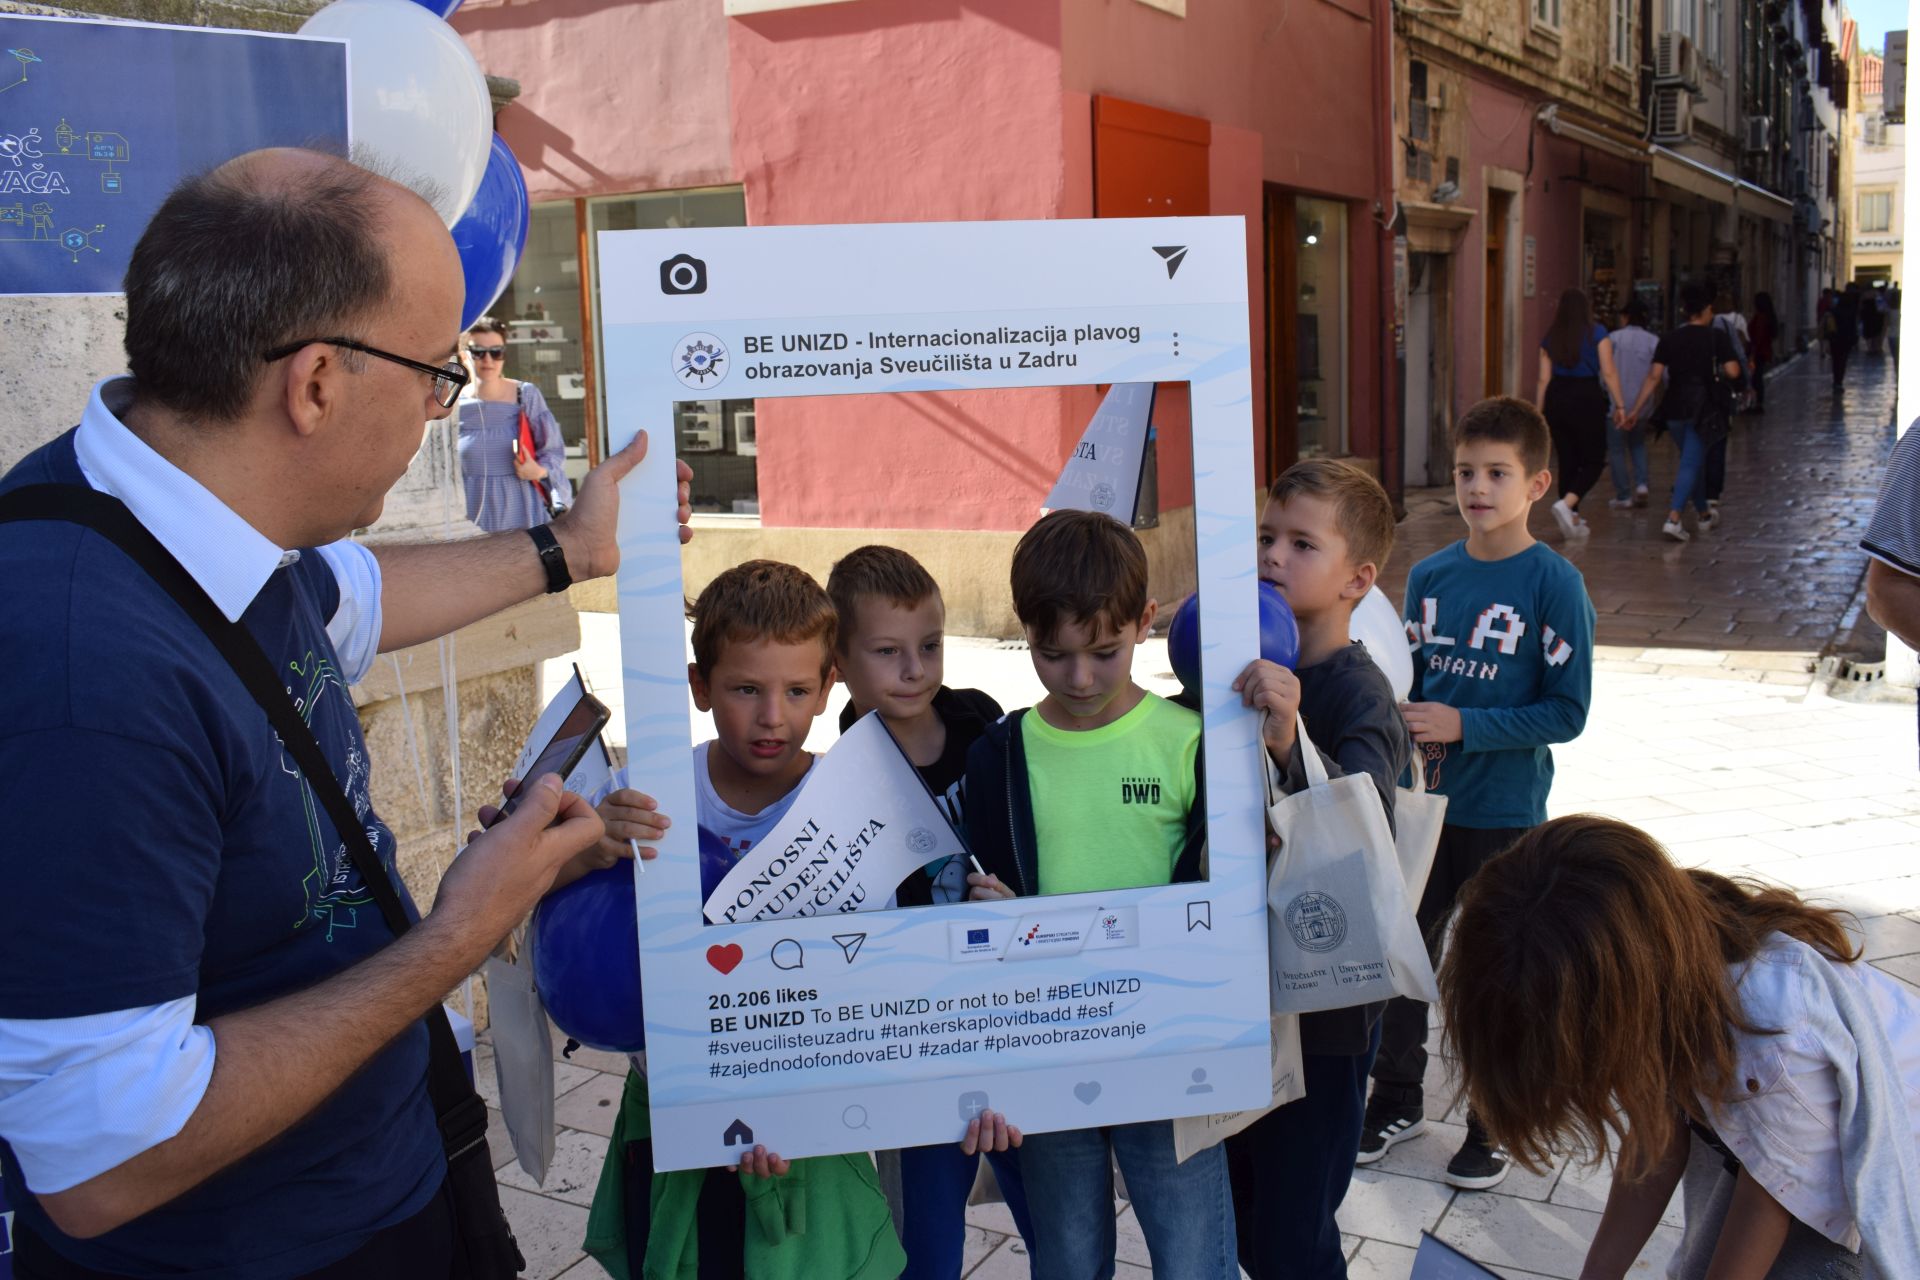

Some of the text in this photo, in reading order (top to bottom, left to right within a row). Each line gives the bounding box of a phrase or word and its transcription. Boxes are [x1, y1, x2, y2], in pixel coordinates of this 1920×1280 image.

[743, 335, 775, 354] BE
[781, 332, 849, 353] UNIZD
[868, 325, 1068, 350] Internacionalizacija
[1074, 323, 1141, 346] plavog
[744, 350, 1077, 380] obrazovanja Sveučilišta u Zadru
[1121, 783, 1161, 805] DWD
[723, 816, 821, 924] PONOSNI
[752, 833, 840, 922] TUDENT
[792, 818, 886, 919] UČILIŠTA
[708, 987, 818, 1011] 20.206 likes
[1292, 980, 1319, 991] ZADRU
[1355, 972, 1383, 983] ZADAR
[710, 977, 1141, 1034] BE UNIZD To BE UNIZD or not to be! #BEUNIZD
[707, 1001, 1114, 1057] #sveucilisteuzadru #tankerskaplovidbadd #esf
[708, 1020, 1147, 1079] #zajednodofondovaEU #zadar #plavoobrazovanje
